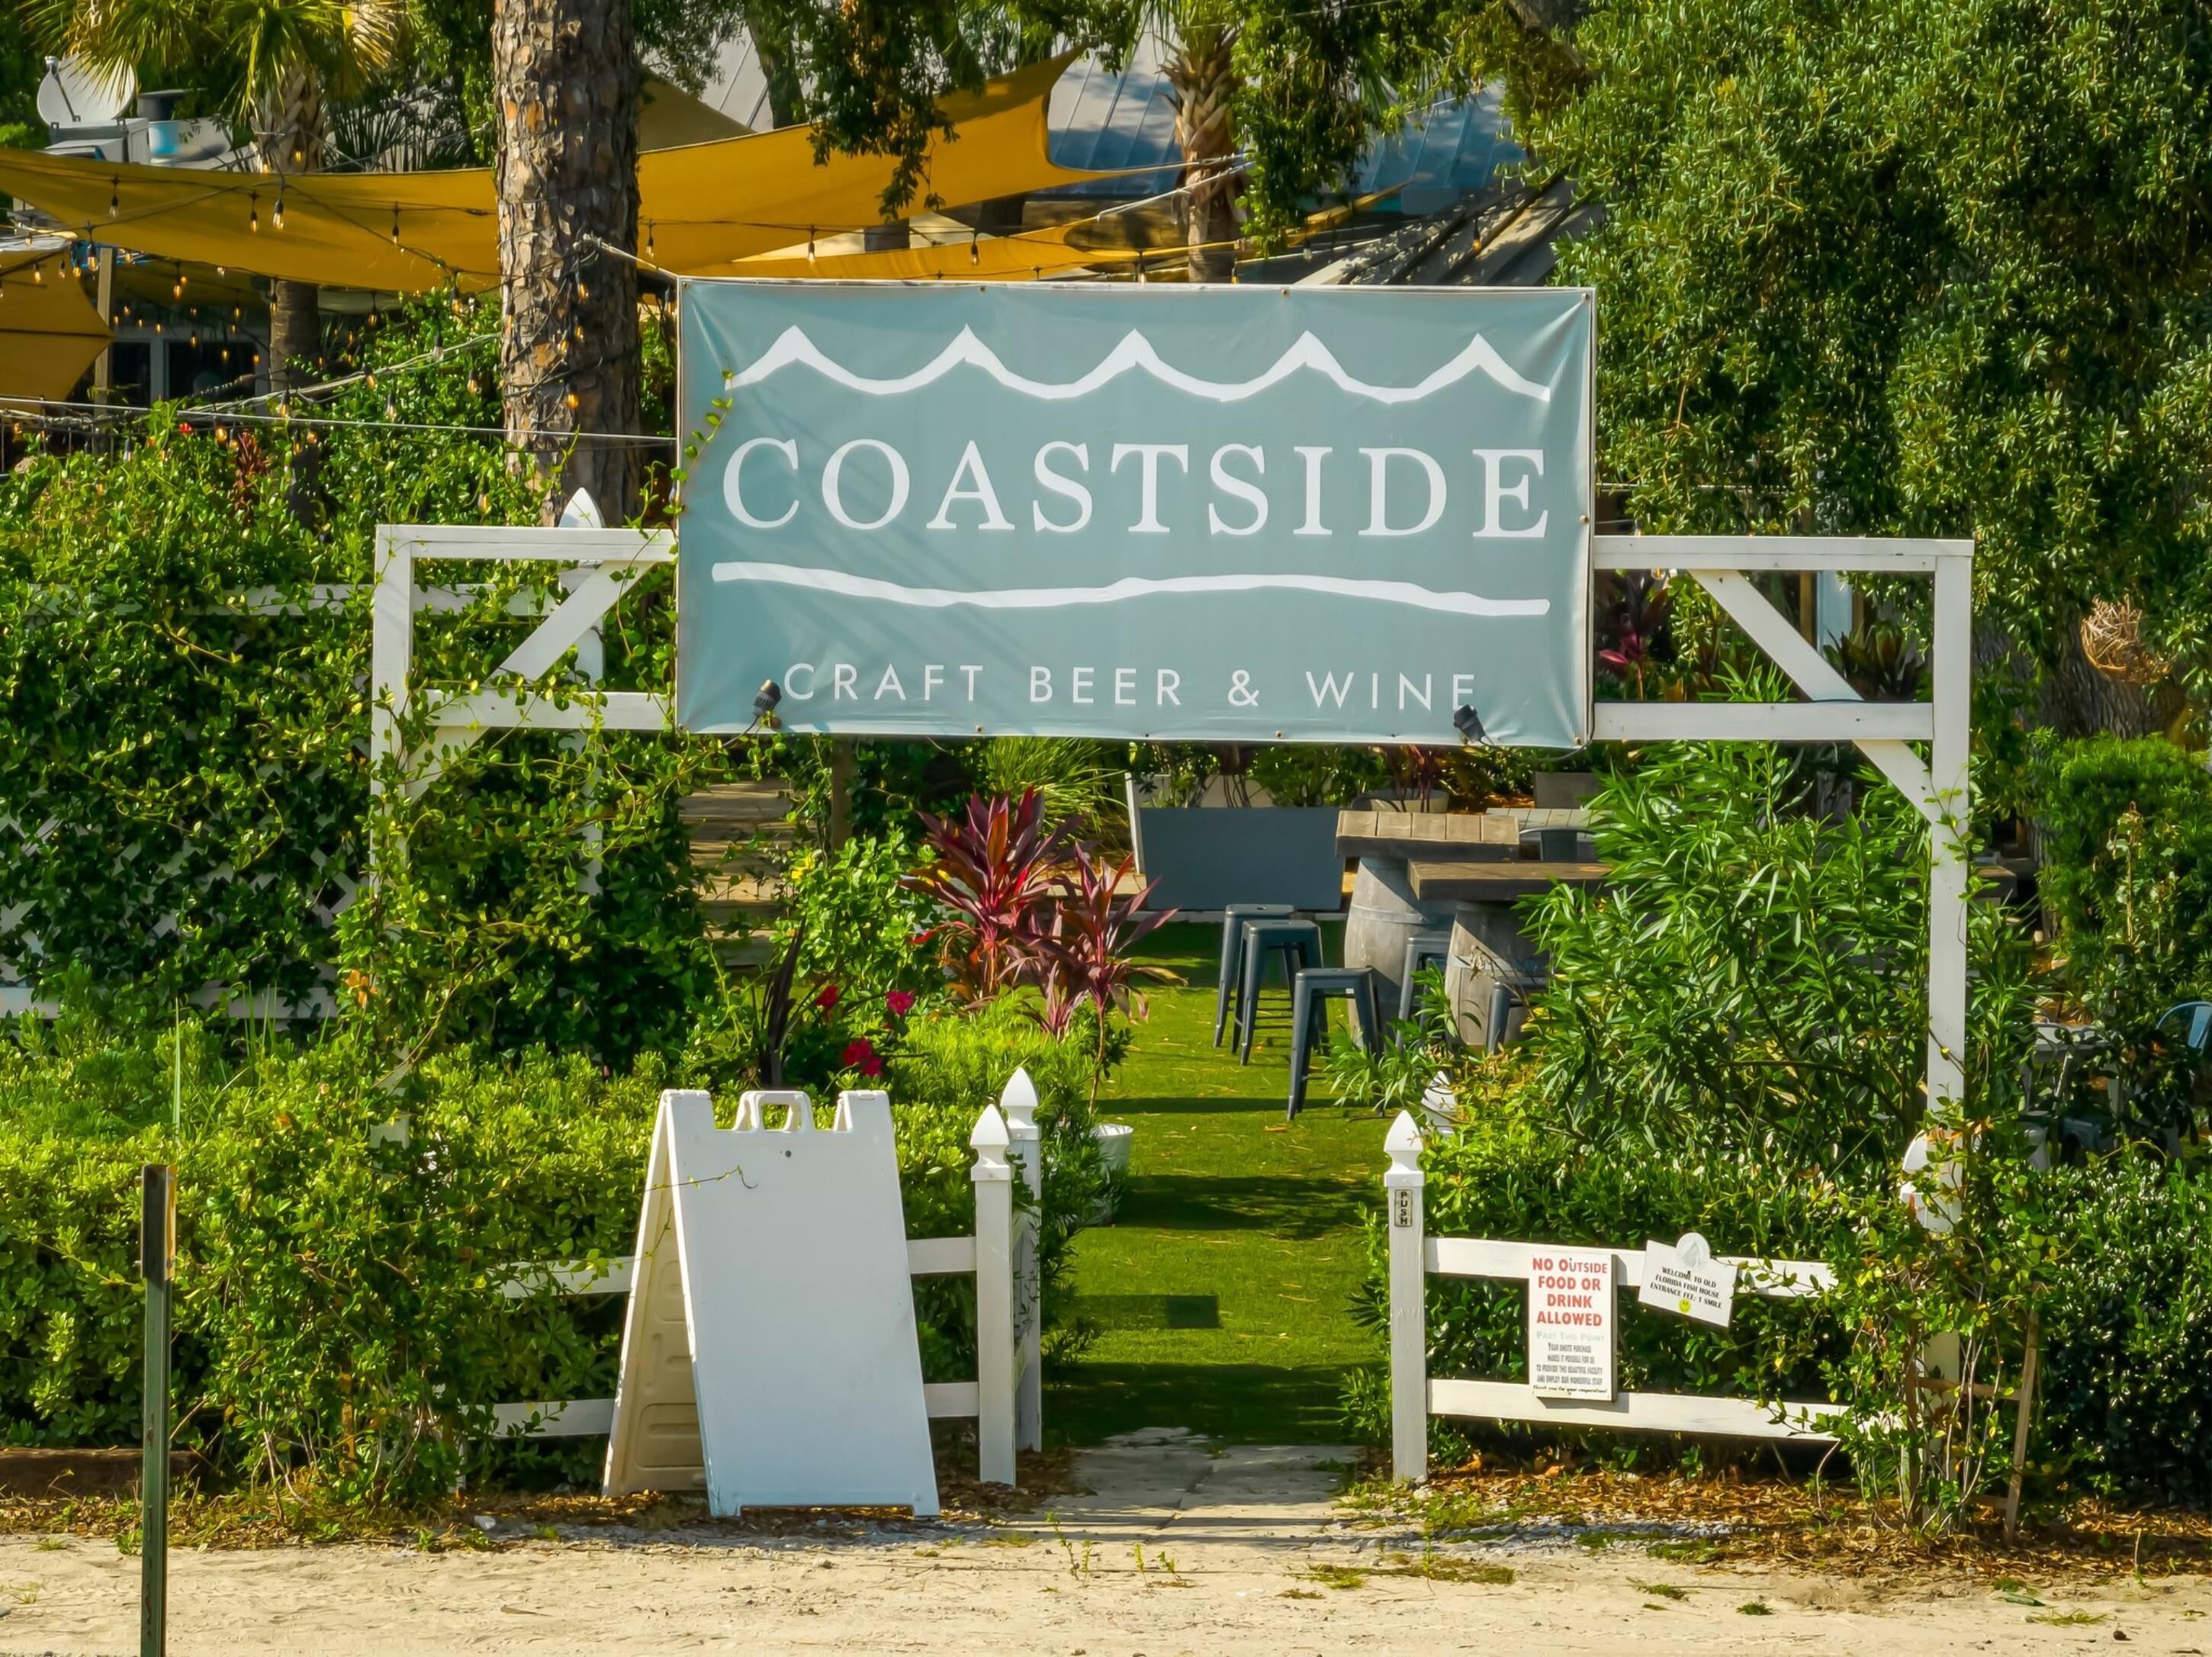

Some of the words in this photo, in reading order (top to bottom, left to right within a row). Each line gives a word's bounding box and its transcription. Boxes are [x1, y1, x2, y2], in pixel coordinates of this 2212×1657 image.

[722, 437, 1549, 539] COASTSIDE
[784, 662, 984, 702] CRAFT
[1030, 665, 1183, 706] BEER
[1229, 668, 1259, 707] &
[1306, 671, 1475, 711] WINE
[1532, 1257, 1554, 1271] NO
[1558, 1258, 1608, 1273] OUTSIDE
[1538, 1276, 1576, 1289] FOOD
[1581, 1277, 1601, 1291] OR
[1655, 1274, 1682, 1287] FLORIDA
[1683, 1282, 1698, 1292] FISH
[1699, 1287, 1719, 1298] HOUSE
[1661, 1266, 1692, 1281] WELCOME
[1694, 1276, 1702, 1284] TO
[1703, 1278, 1717, 1289] OLD
[1547, 1293, 1593, 1308] DRINK
[1650, 1282, 1682, 1297] ENTRANCE
[1704, 1298, 1722, 1309] SMILE
[1536, 1311, 1603, 1327] ALLOWED
